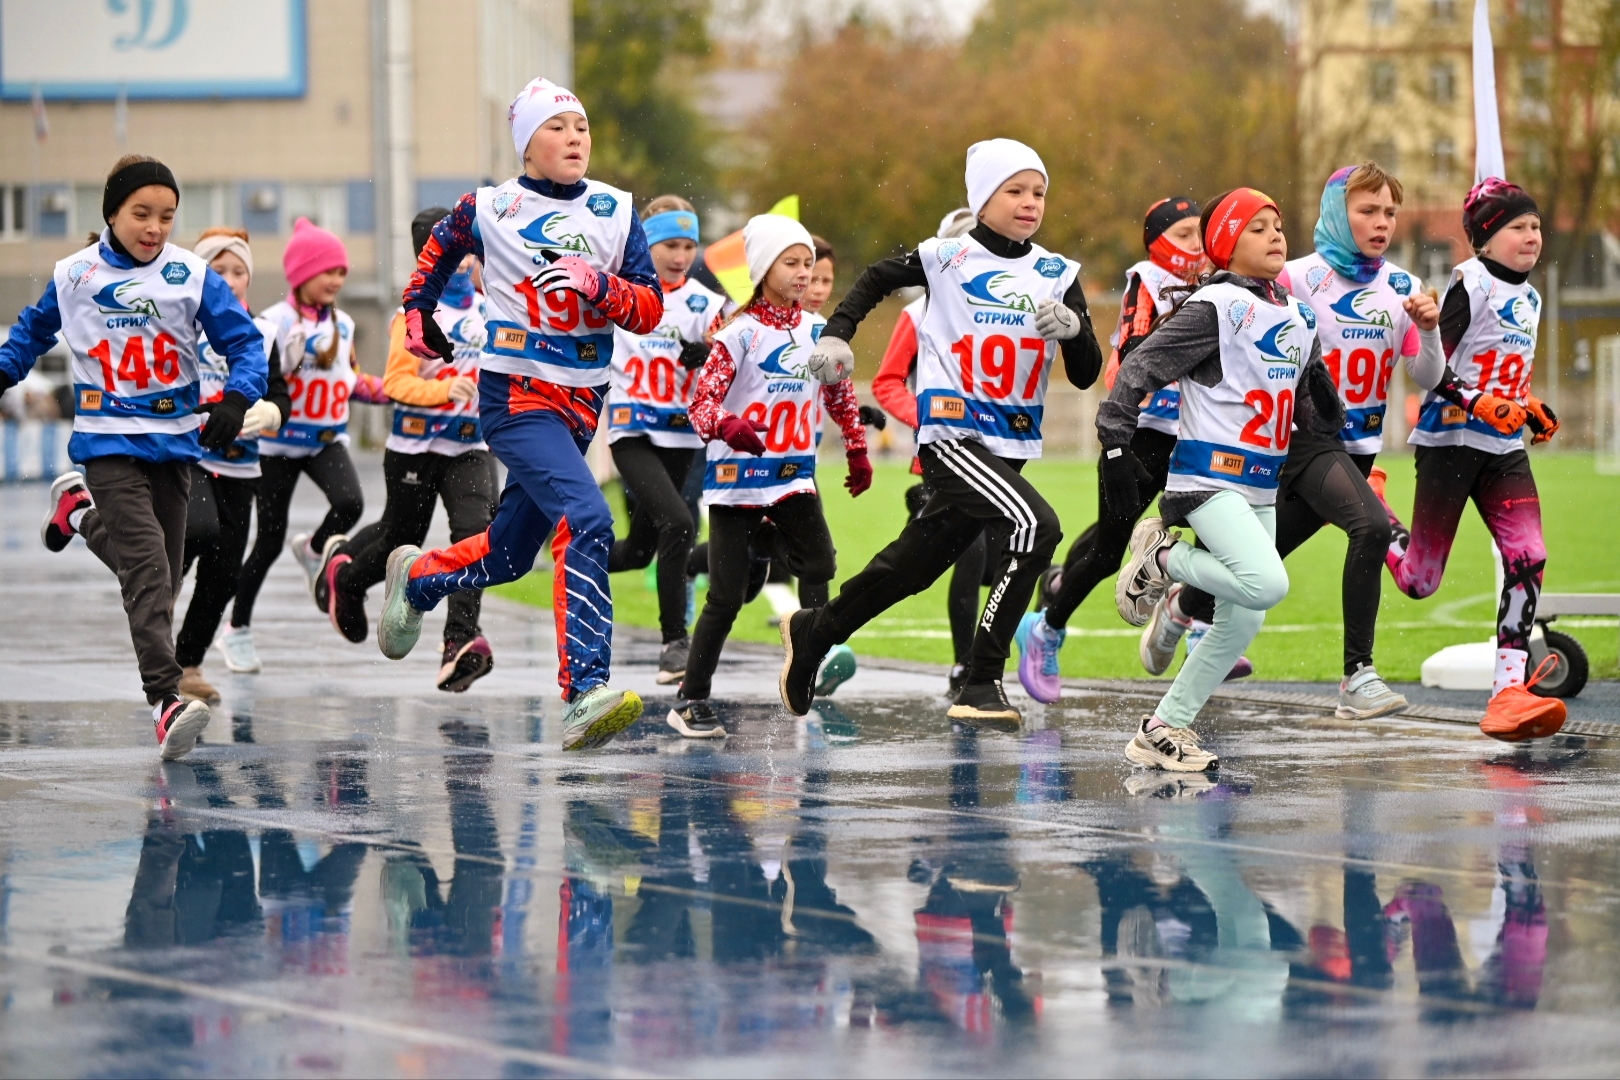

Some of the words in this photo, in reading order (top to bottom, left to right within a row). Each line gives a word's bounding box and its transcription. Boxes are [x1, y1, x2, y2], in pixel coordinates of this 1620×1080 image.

[106, 316, 150, 330] СТРИЖ
[974, 311, 1025, 326] СТРИЖ
[506, 332, 524, 344] ИЗТТ
[1341, 327, 1386, 340] СТРИЖ
[87, 332, 180, 393] 146
[950, 333, 1045, 399] 197
[1321, 347, 1395, 404] 196
[767, 382, 805, 394] СТРИЖ
[286, 376, 351, 420] 208
[944, 402, 962, 413] ИЗТТ
[979, 414, 996, 423] ПСБ
[1223, 457, 1242, 469] ИЗТТ
[754, 469, 770, 477] ПСБ
[981, 575, 1012, 633] TERREX
